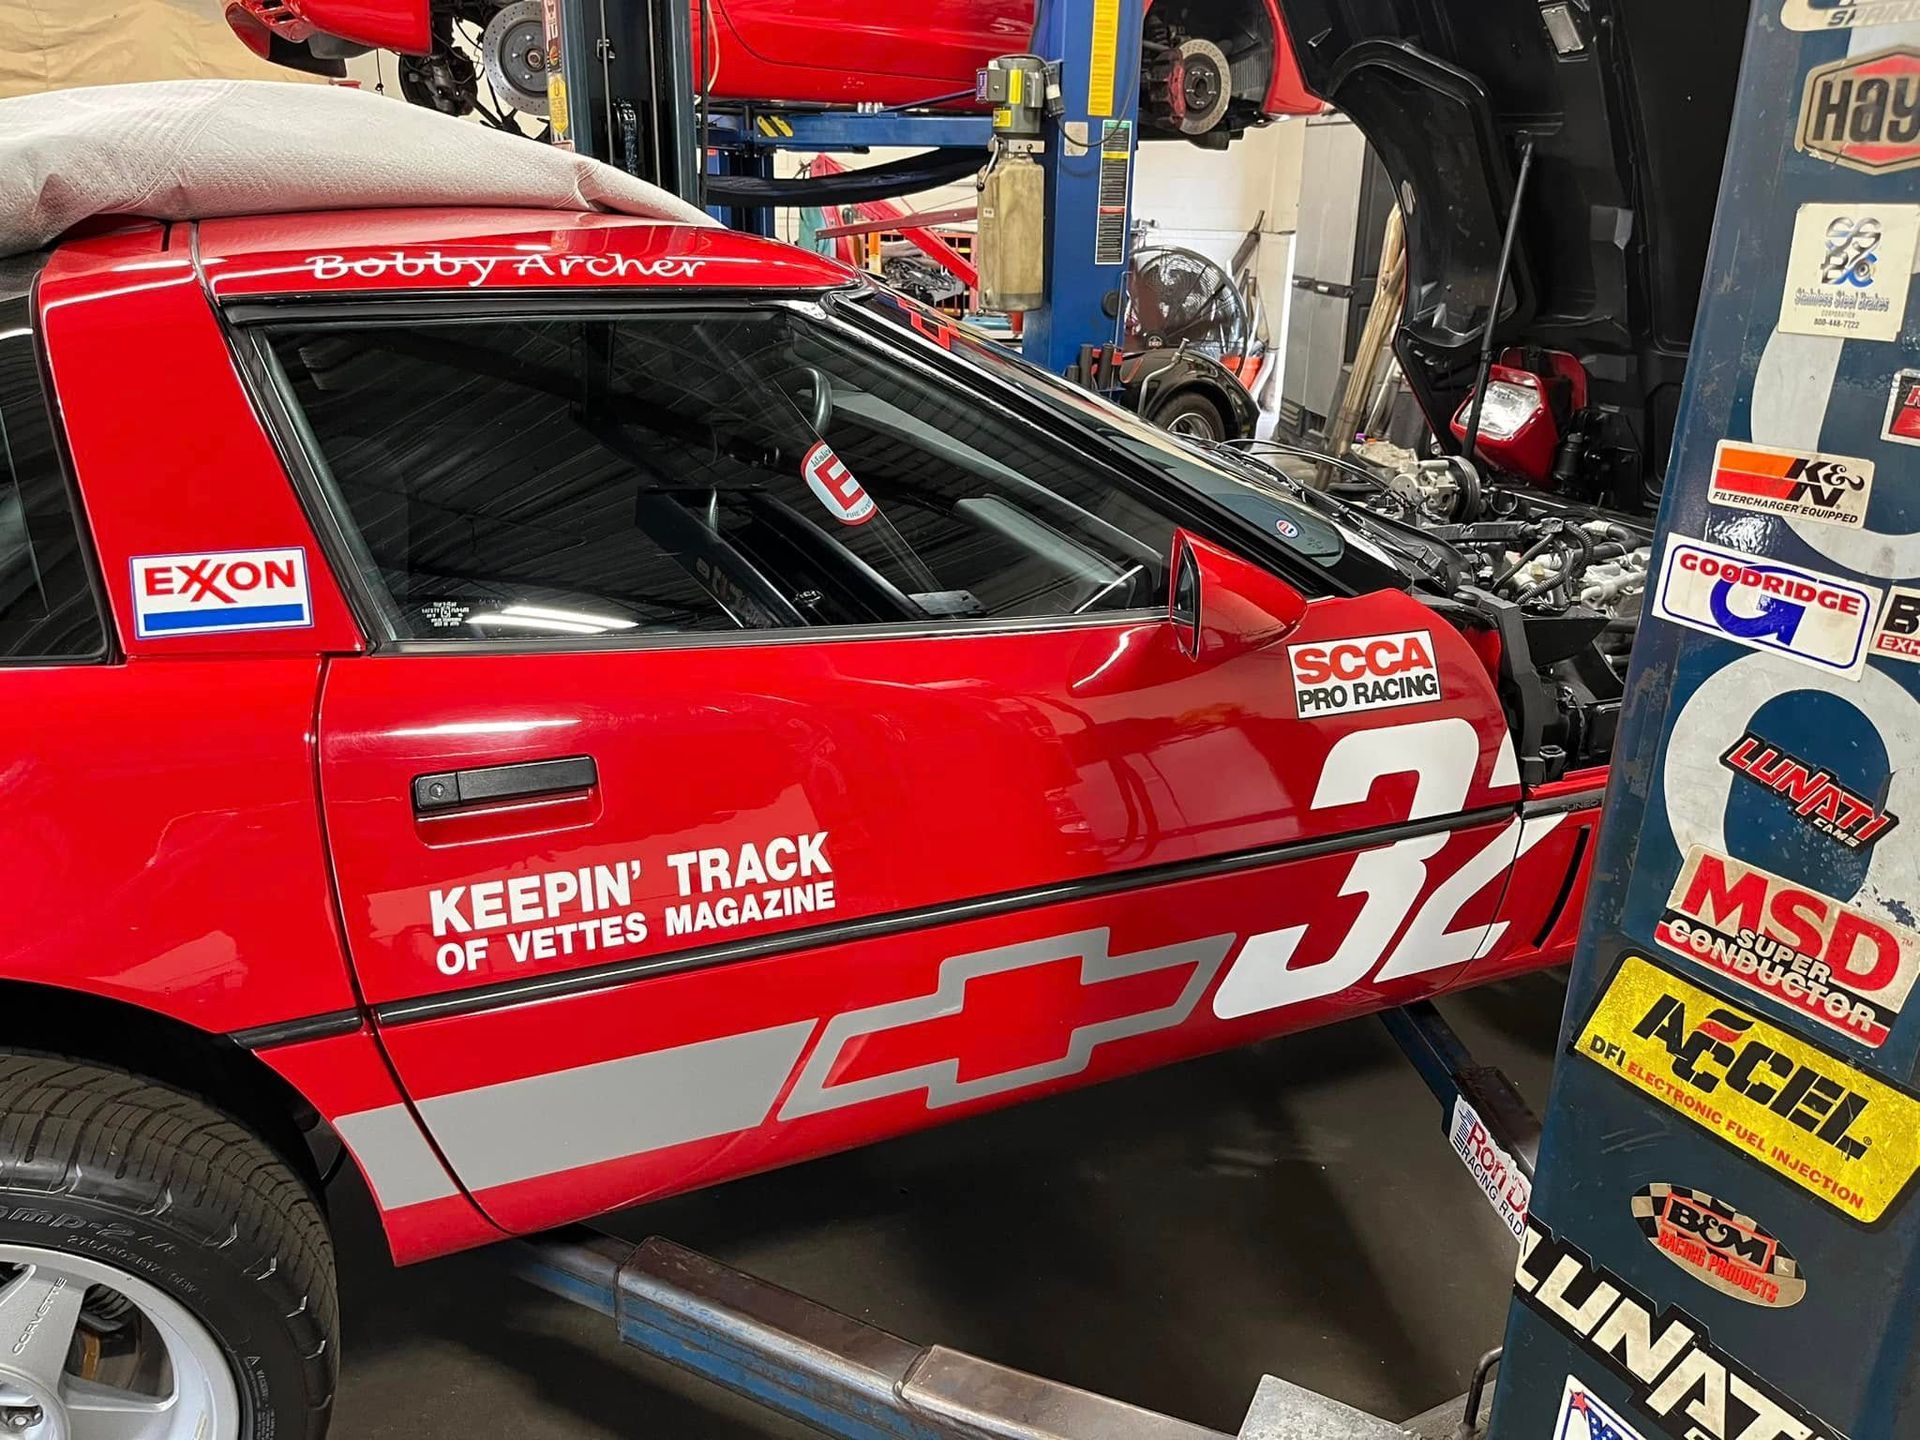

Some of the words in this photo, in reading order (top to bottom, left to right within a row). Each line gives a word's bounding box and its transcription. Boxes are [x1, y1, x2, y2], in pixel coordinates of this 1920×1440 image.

[306, 252, 496, 287] Bobby
[513, 253, 706, 277] Archer
[1795, 287, 1833, 308] Stainless
[1834, 289, 1857, 310] Steel
[1858, 292, 1890, 311] Brakes
[813, 453, 866, 511] E
[1713, 491, 1798, 514] FILTERCHARGER
[1800, 505, 1859, 524] EQUIPPED
[1785, 458, 1865, 508] K&N
[144, 559, 297, 604] EXXON
[1679, 553, 1861, 616] GOODRIDGE
[1294, 637, 1434, 685] SCCA
[1298, 685, 1348, 713] PRO
[1353, 673, 1438, 705] RACING
[1727, 738, 1891, 841] LUNATI
[1813, 817, 1861, 849] CAMS
[429, 860, 642, 938] KEEPIN'
[666, 831, 833, 898] TRACK
[1213, 718, 1568, 1020] 32
[436, 937, 490, 976] OF
[506, 911, 649, 963] VETTES
[664, 880, 836, 937] MAGAZINE
[1681, 853, 1901, 992] MSD
[1735, 927, 1832, 985] SUPER
[1669, 919, 1877, 1033] CONDUCTOR
[1632, 993, 1870, 1161] ACCEL
[1466, 1121, 1507, 1191] Ron
[1589, 1034, 1627, 1069] DFI
[1626, 1061, 1723, 1125] ELECTRONIC
[1725, 1119, 1767, 1153] FUEL
[1771, 1145, 1865, 1210] INJECTION
[1461, 1145, 1499, 1201] RACING
[1658, 1230, 1706, 1268] RACING
[1708, 1253, 1780, 1304] PRODUCTS
[1667, 1198, 1768, 1267] B&M
[12, 1277, 68, 1356] CORVETTE
[1514, 1225, 1828, 1440] LUNAT
